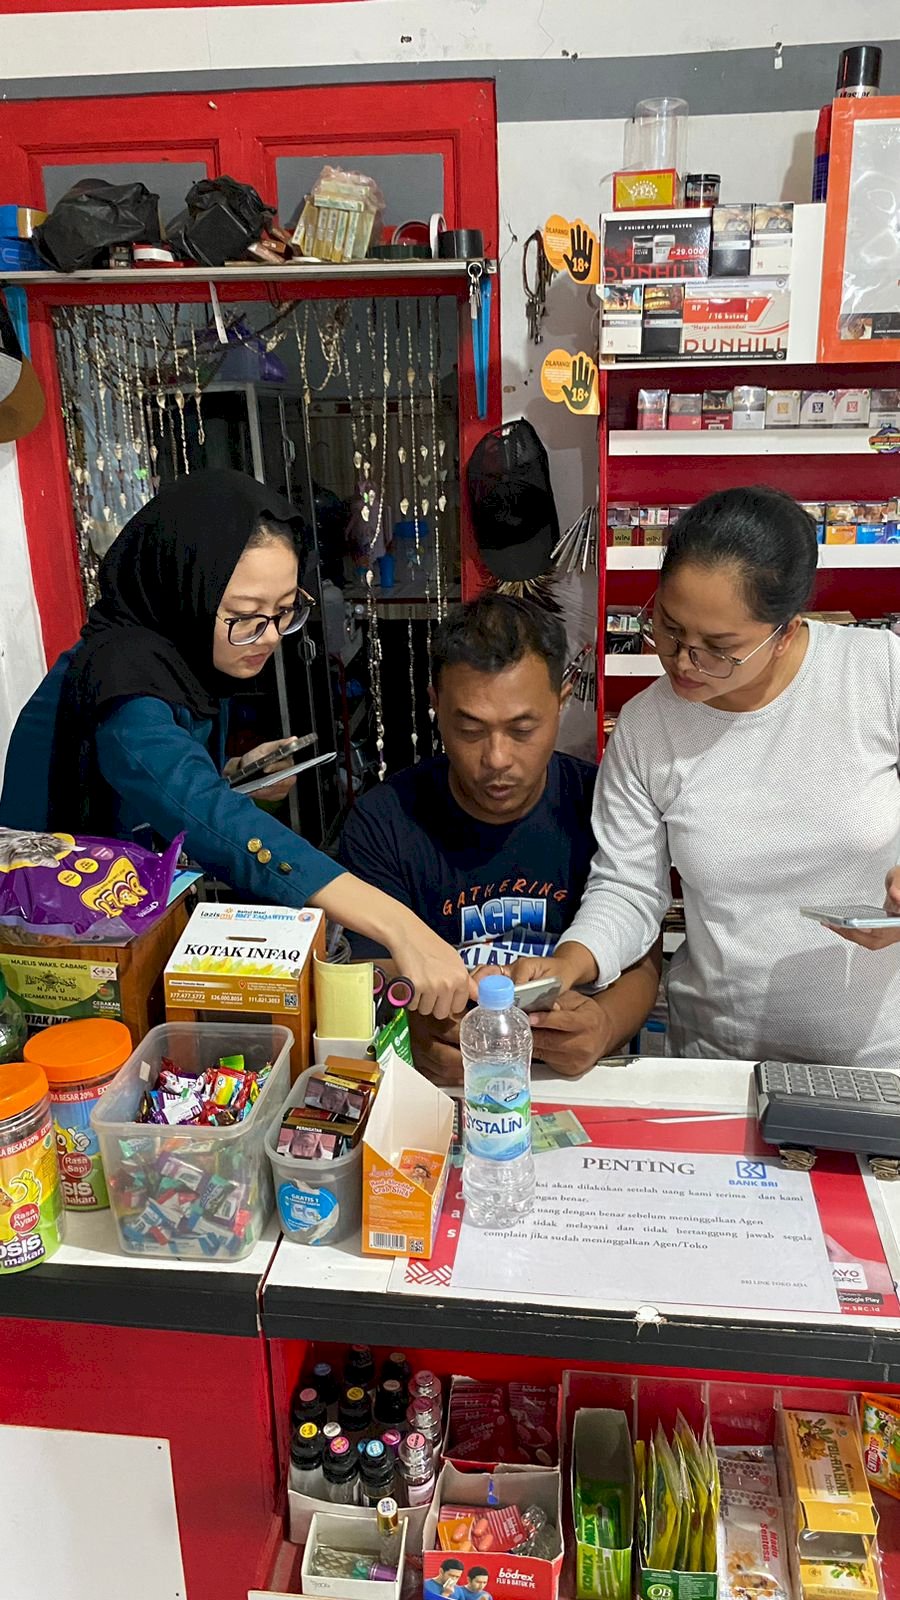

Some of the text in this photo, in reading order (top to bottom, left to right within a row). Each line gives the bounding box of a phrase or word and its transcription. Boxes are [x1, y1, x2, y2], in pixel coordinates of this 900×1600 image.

[572, 257, 589, 272] 18+
[604, 263, 704, 281] DUNHILL
[684, 337, 785, 353] DUNHILL
[571, 388, 589, 402] 18+
[442, 878, 568, 916] GATHERING
[461, 896, 547, 944] AGEN
[184, 944, 301, 961] KOTAK INFAQ
[11, 959, 37, 967] MAJELIS
[59, 1093, 79, 1101] BESAR
[80, 1091, 94, 1100] 20%
[296, 1125, 322, 1133] PERINGATAN
[7, 1141, 27, 1155] BESAR
[28, 1134, 39, 1146] 20%
[64, 1156, 88, 1164] Rasa
[582, 1157, 696, 1175] PENTING
[67, 1165, 88, 1173] Sapi
[577, 1183, 623, 1192] dilakukan
[662, 1188, 685, 1197] uang
[560, 1194, 589, 1202] benar.
[13, 1214, 39, 1229] Ayam
[14, 1209, 36, 1220] Rasa
[562, 1208, 596, 1217] dengan
[599, 1210, 625, 1218] benar
[627, 1212, 666, 1220] sebelum
[669, 1214, 736, 1224] meninggalkan
[739, 1218, 763, 1226] Agen
[566, 1222, 608, 1231] melayani
[643, 1226, 668, 1234] tidak
[676, 1227, 738, 1238] bertanggung
[746, 1230, 774, 1239] jawab
[783, 1234, 812, 1242] segala
[483, 1231, 527, 1239] complain
[530, 1232, 548, 1240] jika
[582, 1237, 650, 1246] meninggalkan
[652, 1240, 708, 1249] Agen/Toko
[4, 1247, 45, 1266] makan
[832, 1269, 859, 1277] AYO
[839, 1295, 865, 1303] Google
[760, 1521, 770, 1562] Sentosa
[582, 1553, 594, 1591] KOMIX
[650, 1587, 672, 1597] OB
